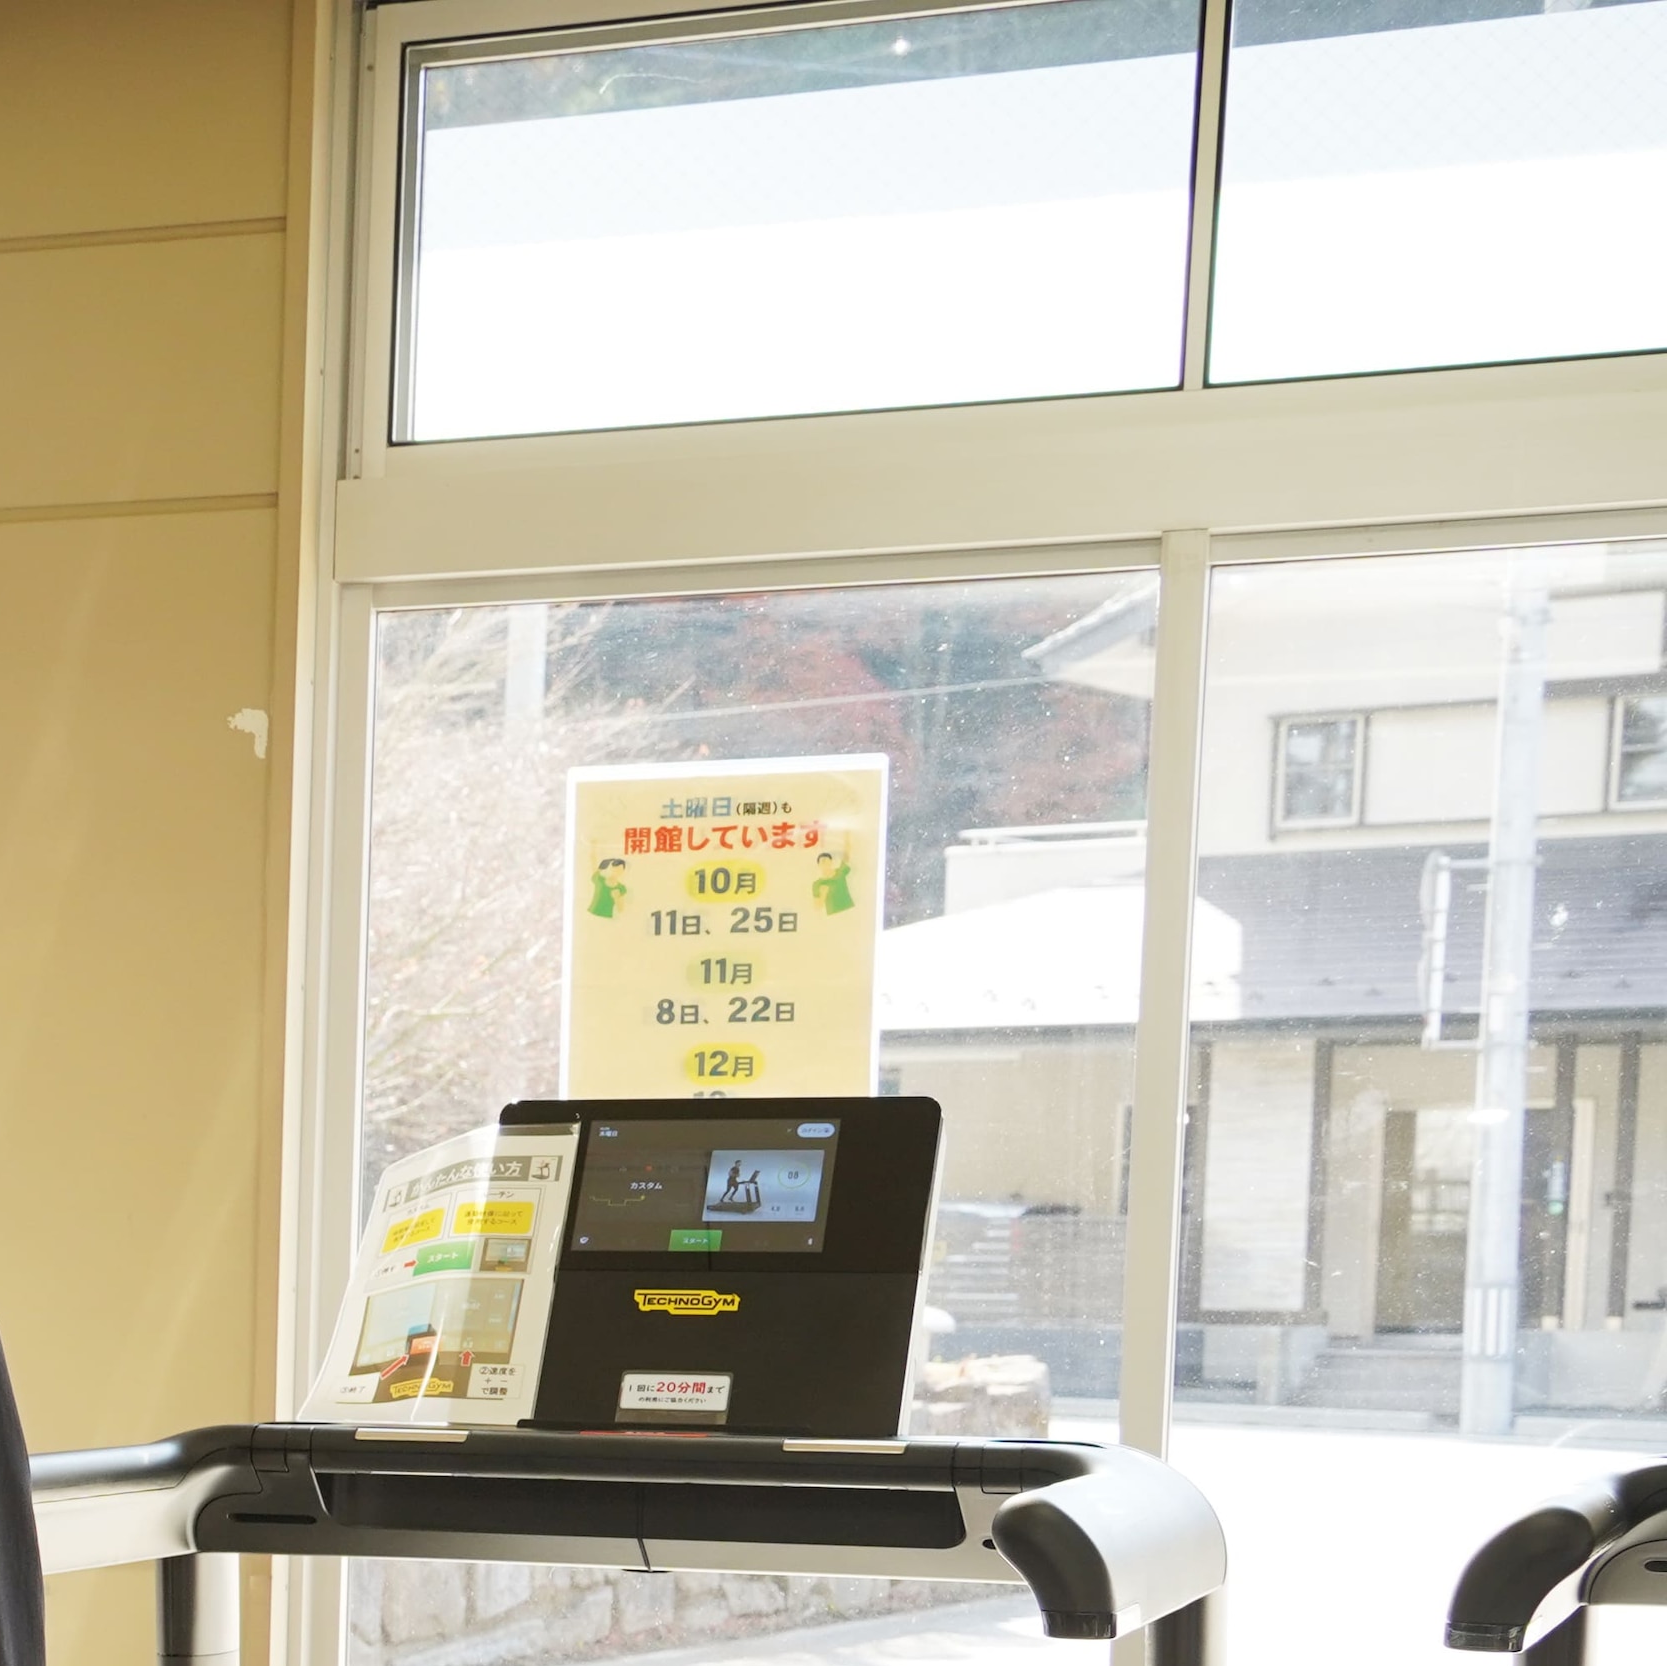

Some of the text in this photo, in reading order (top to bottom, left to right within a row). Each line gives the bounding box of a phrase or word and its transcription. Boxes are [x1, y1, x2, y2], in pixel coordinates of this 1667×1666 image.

[624, 820, 822, 855] 開館しています
[694, 867, 758, 895] 10月
[700, 958, 753, 984] 11月
[694, 1050, 754, 1078] 12月
[629, 1182, 663, 1191] カスタム
[427, 1251, 459, 1264] スタート
